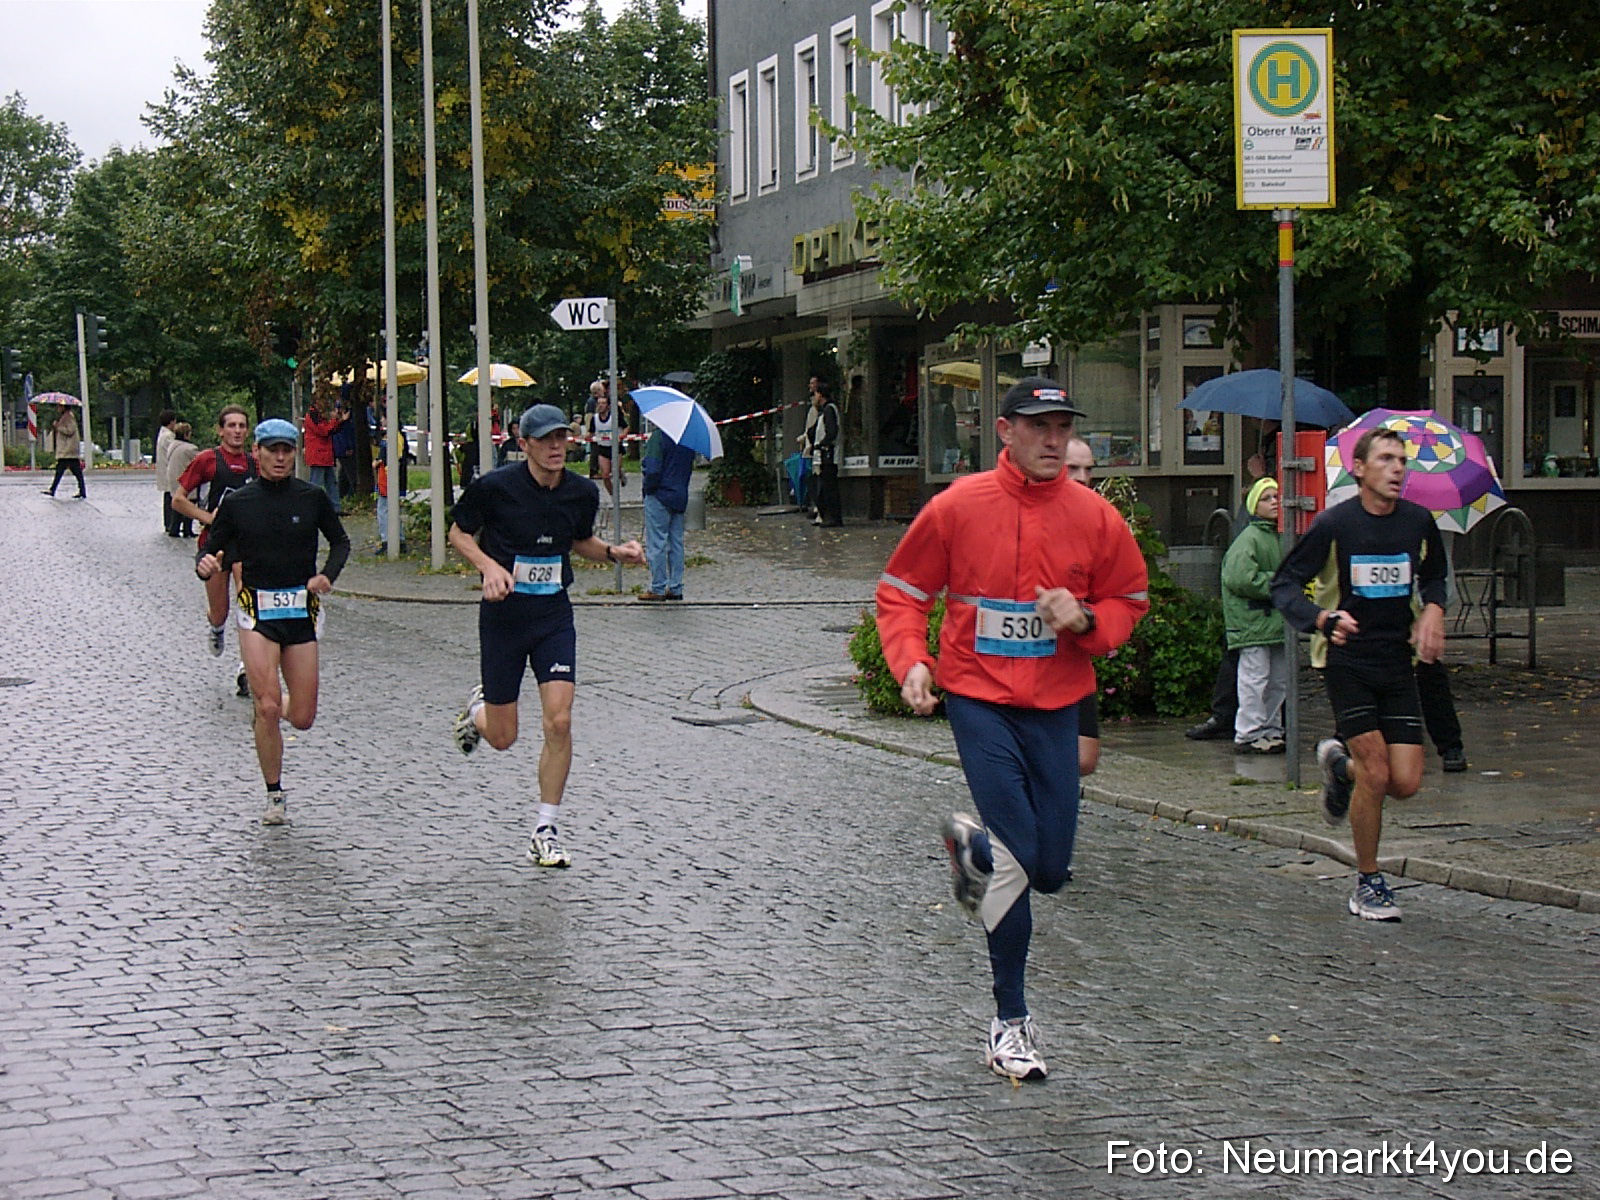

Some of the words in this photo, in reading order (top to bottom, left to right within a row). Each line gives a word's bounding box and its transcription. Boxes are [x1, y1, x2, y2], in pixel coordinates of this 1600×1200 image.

[1267, 59, 1301, 99] H
[1247, 126, 1286, 137] Oberer
[1290, 125, 1322, 136] Markt
[568, 302, 601, 325] WC
[1561, 316, 1600, 334] SCHM
[528, 567, 553, 582] 628
[1370, 567, 1400, 584] 509
[273, 592, 298, 608] 537
[1001, 616, 1043, 639] 530
